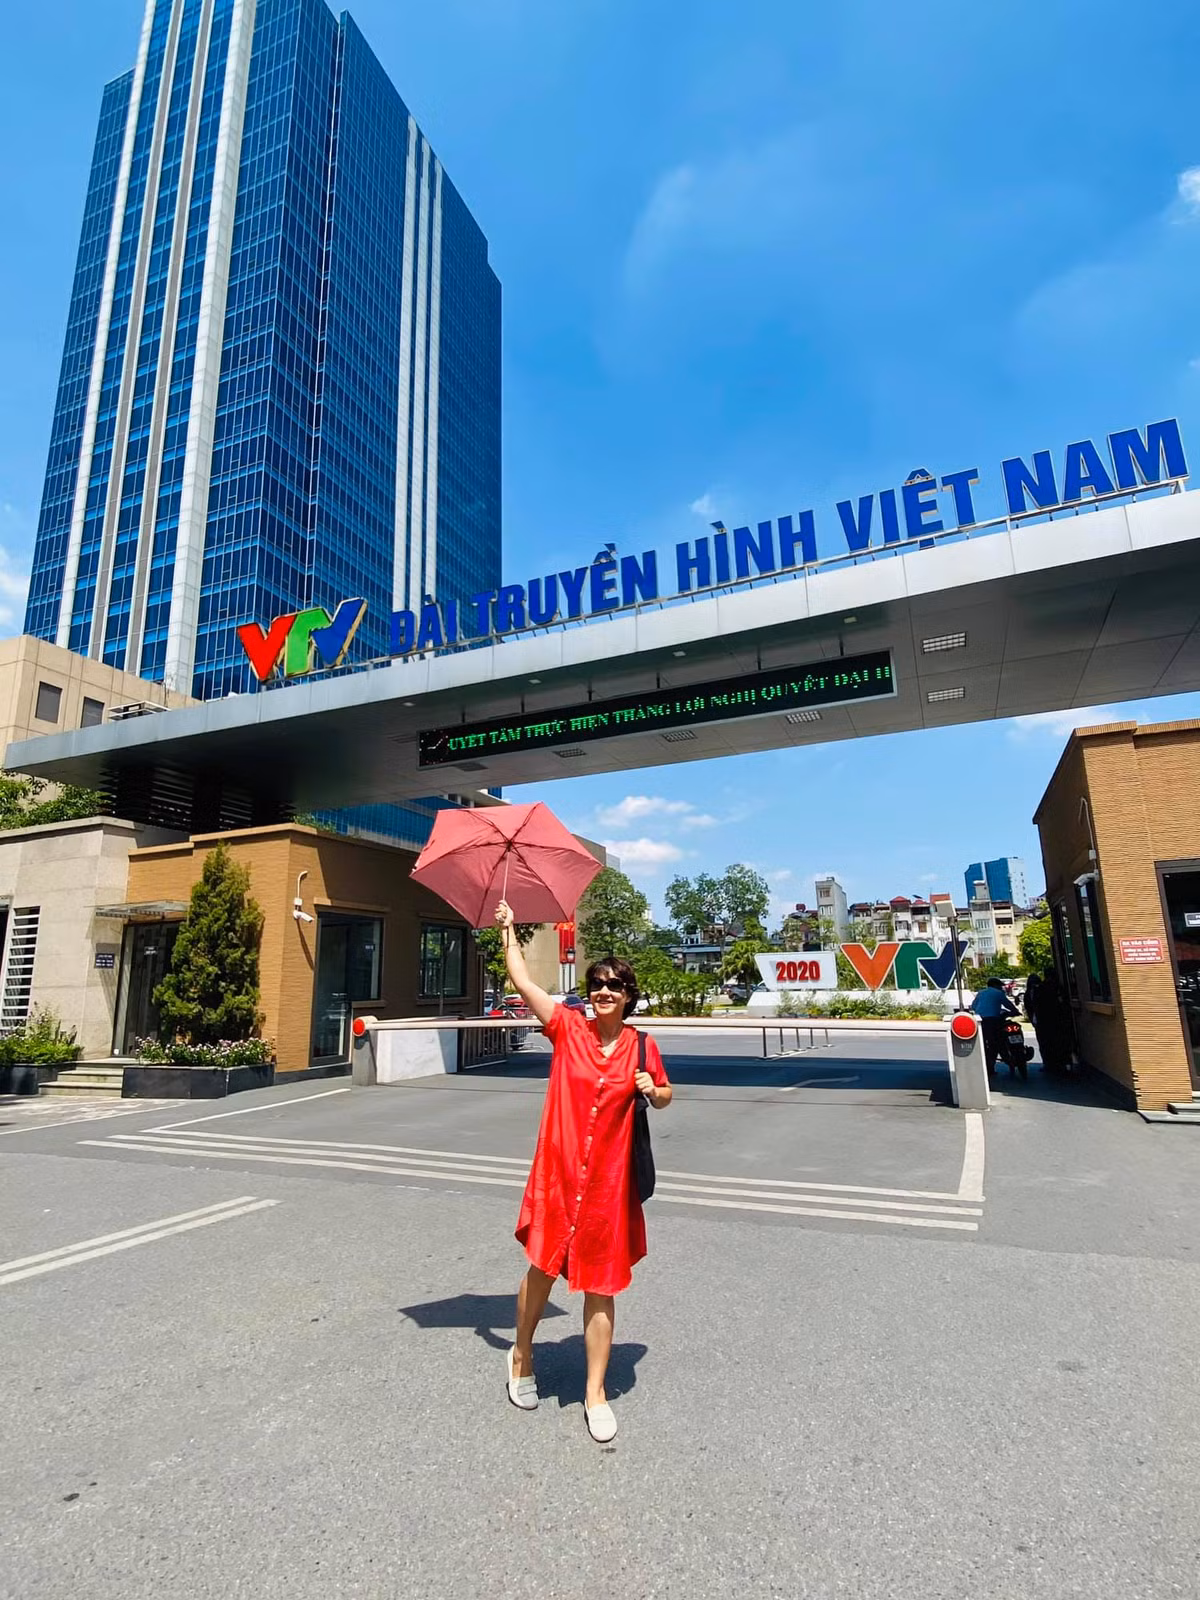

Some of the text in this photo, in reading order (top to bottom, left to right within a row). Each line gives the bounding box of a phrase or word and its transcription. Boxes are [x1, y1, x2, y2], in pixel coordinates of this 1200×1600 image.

[237, 418, 1189, 681] VTV ĐÀI TRUYỀN HÌNH VIỆT NAM
[775, 960, 821, 982] 2020
[840, 940, 969, 990] VTV
